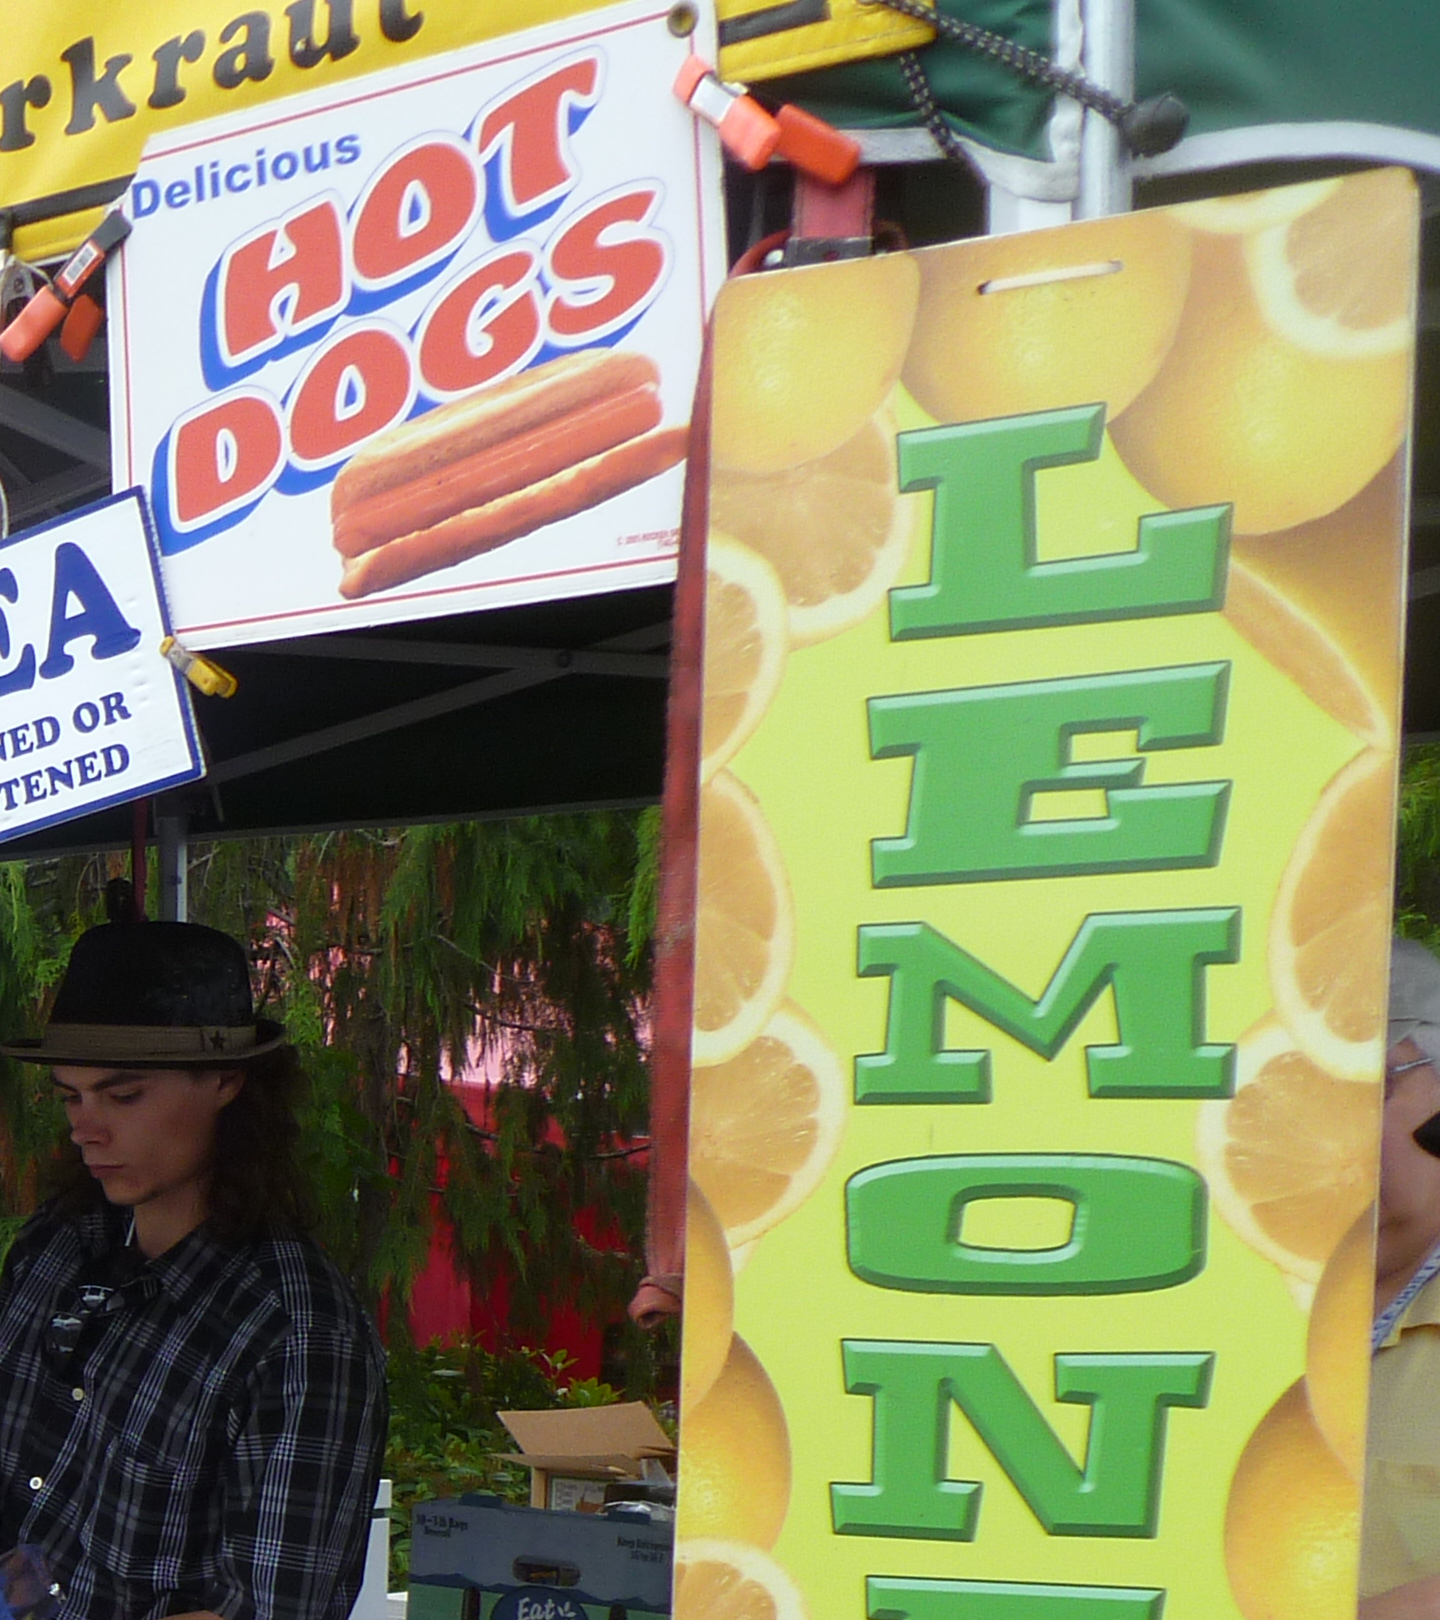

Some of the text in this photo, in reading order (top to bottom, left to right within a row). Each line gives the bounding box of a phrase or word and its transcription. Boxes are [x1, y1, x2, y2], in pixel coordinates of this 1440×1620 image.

[132, 130, 364, 219] Delicious
[205, 50, 604, 387] HOT
[153, 180, 667, 548] DOGS
[73, 691, 131, 733] OR
